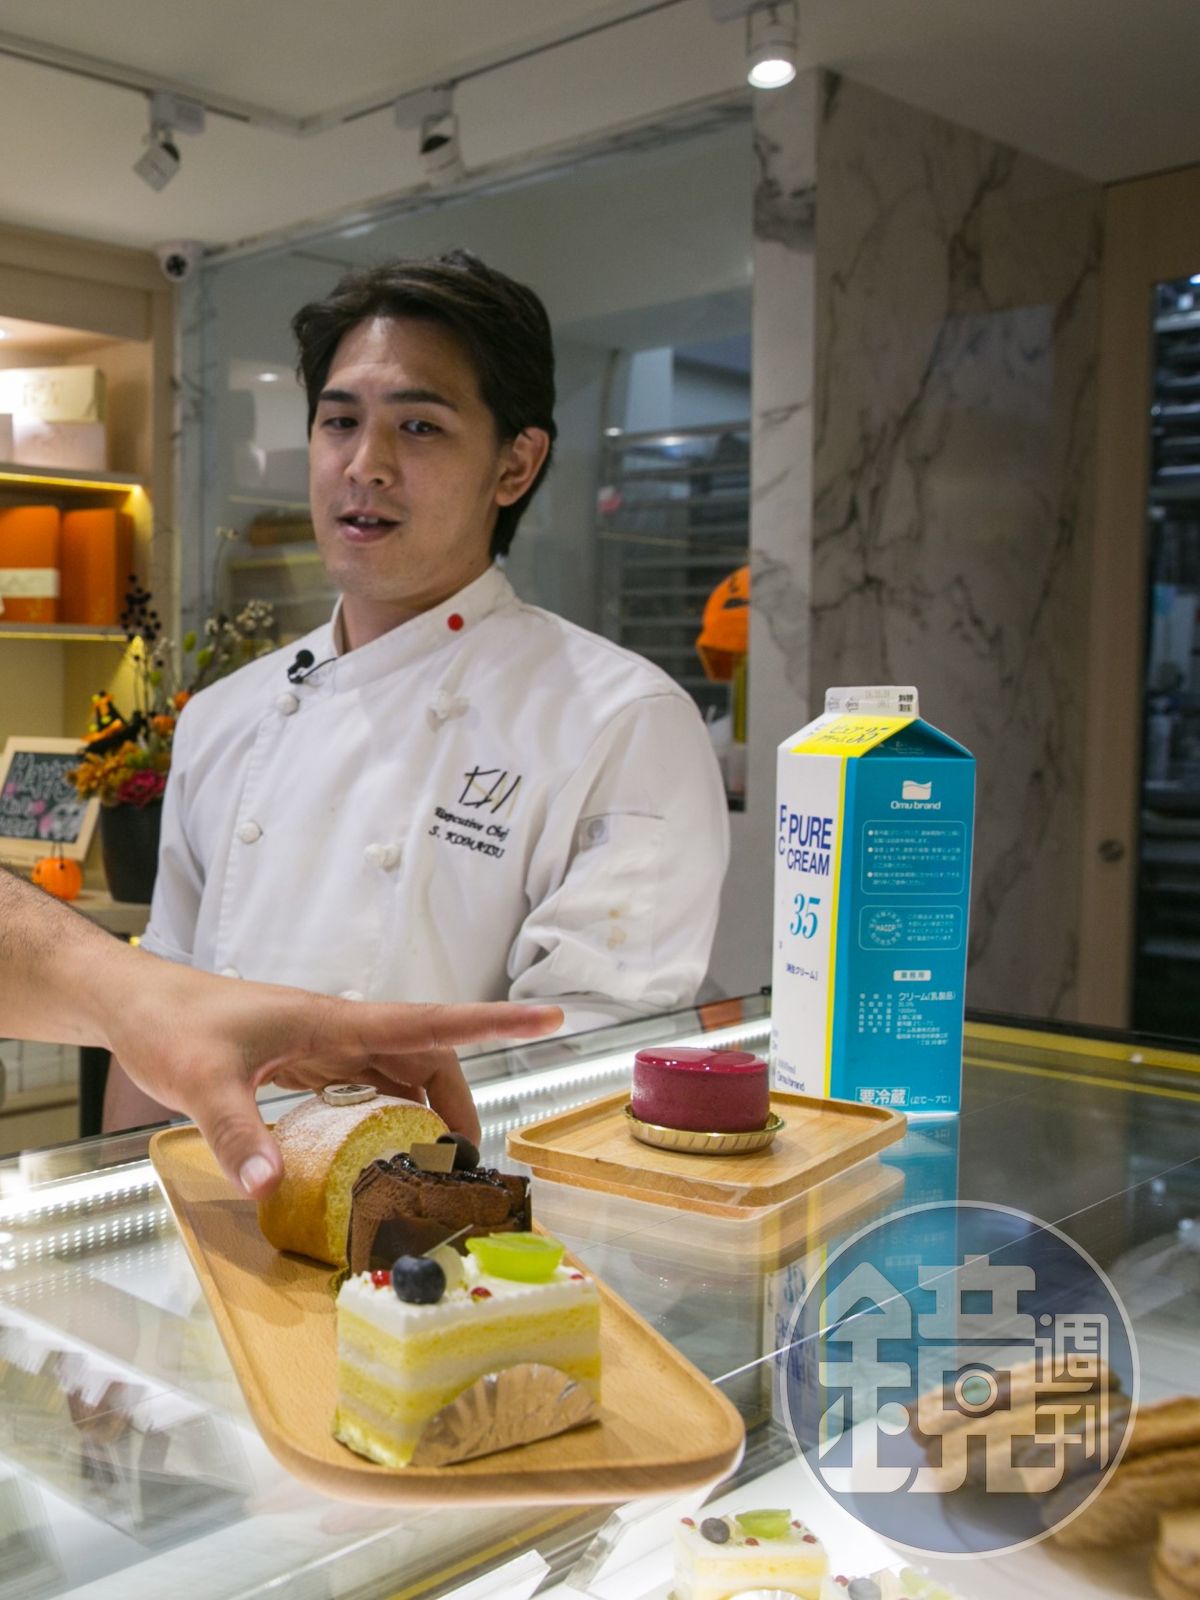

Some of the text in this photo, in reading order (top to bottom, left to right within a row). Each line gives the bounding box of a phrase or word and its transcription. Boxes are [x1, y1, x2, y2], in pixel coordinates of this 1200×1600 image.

[890, 800, 942, 810] Omu brand
[428, 825, 441, 839] S.
[788, 813, 834, 851] PURE
[786, 848, 831, 877] CREAM
[789, 893, 822, 940] 35
[859, 1088, 907, 1105] 要冷蔵
